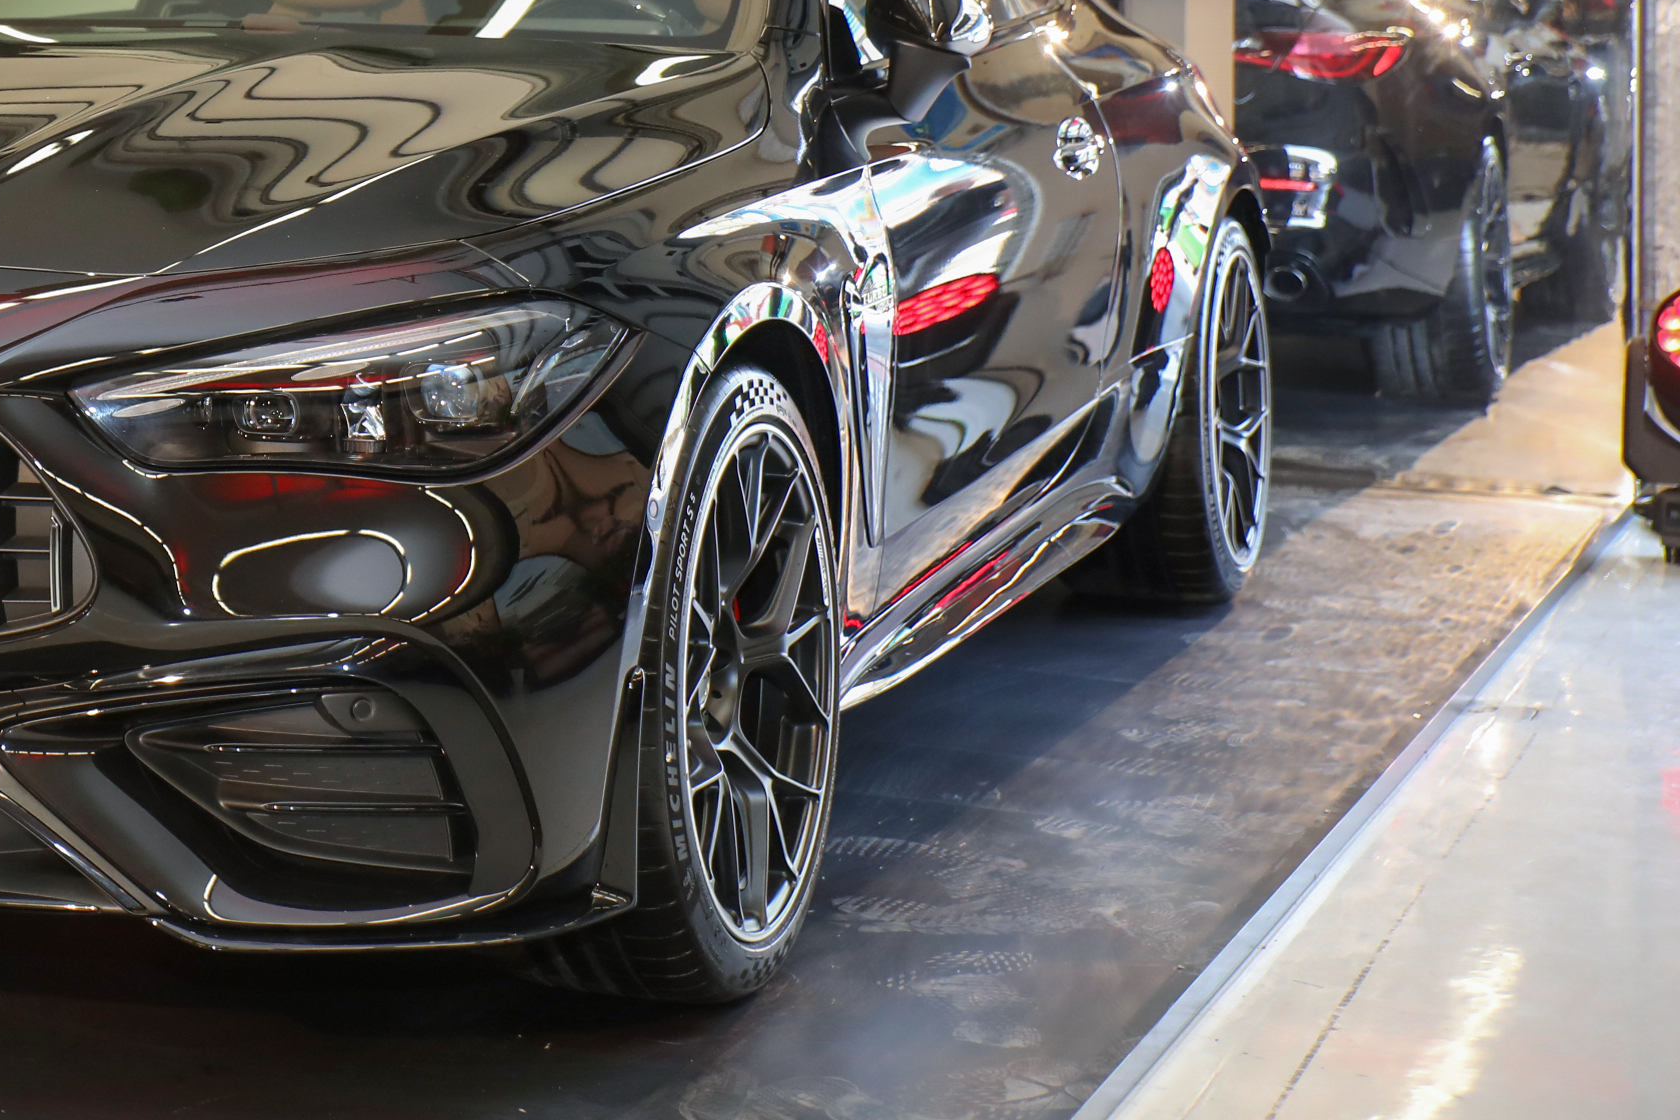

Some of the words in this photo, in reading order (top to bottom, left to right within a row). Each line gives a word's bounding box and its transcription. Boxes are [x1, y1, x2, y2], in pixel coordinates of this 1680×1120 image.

[668, 583, 681, 642] PILOT
[675, 520, 691, 582] SPORT
[665, 662, 689, 861] MICHELIN
